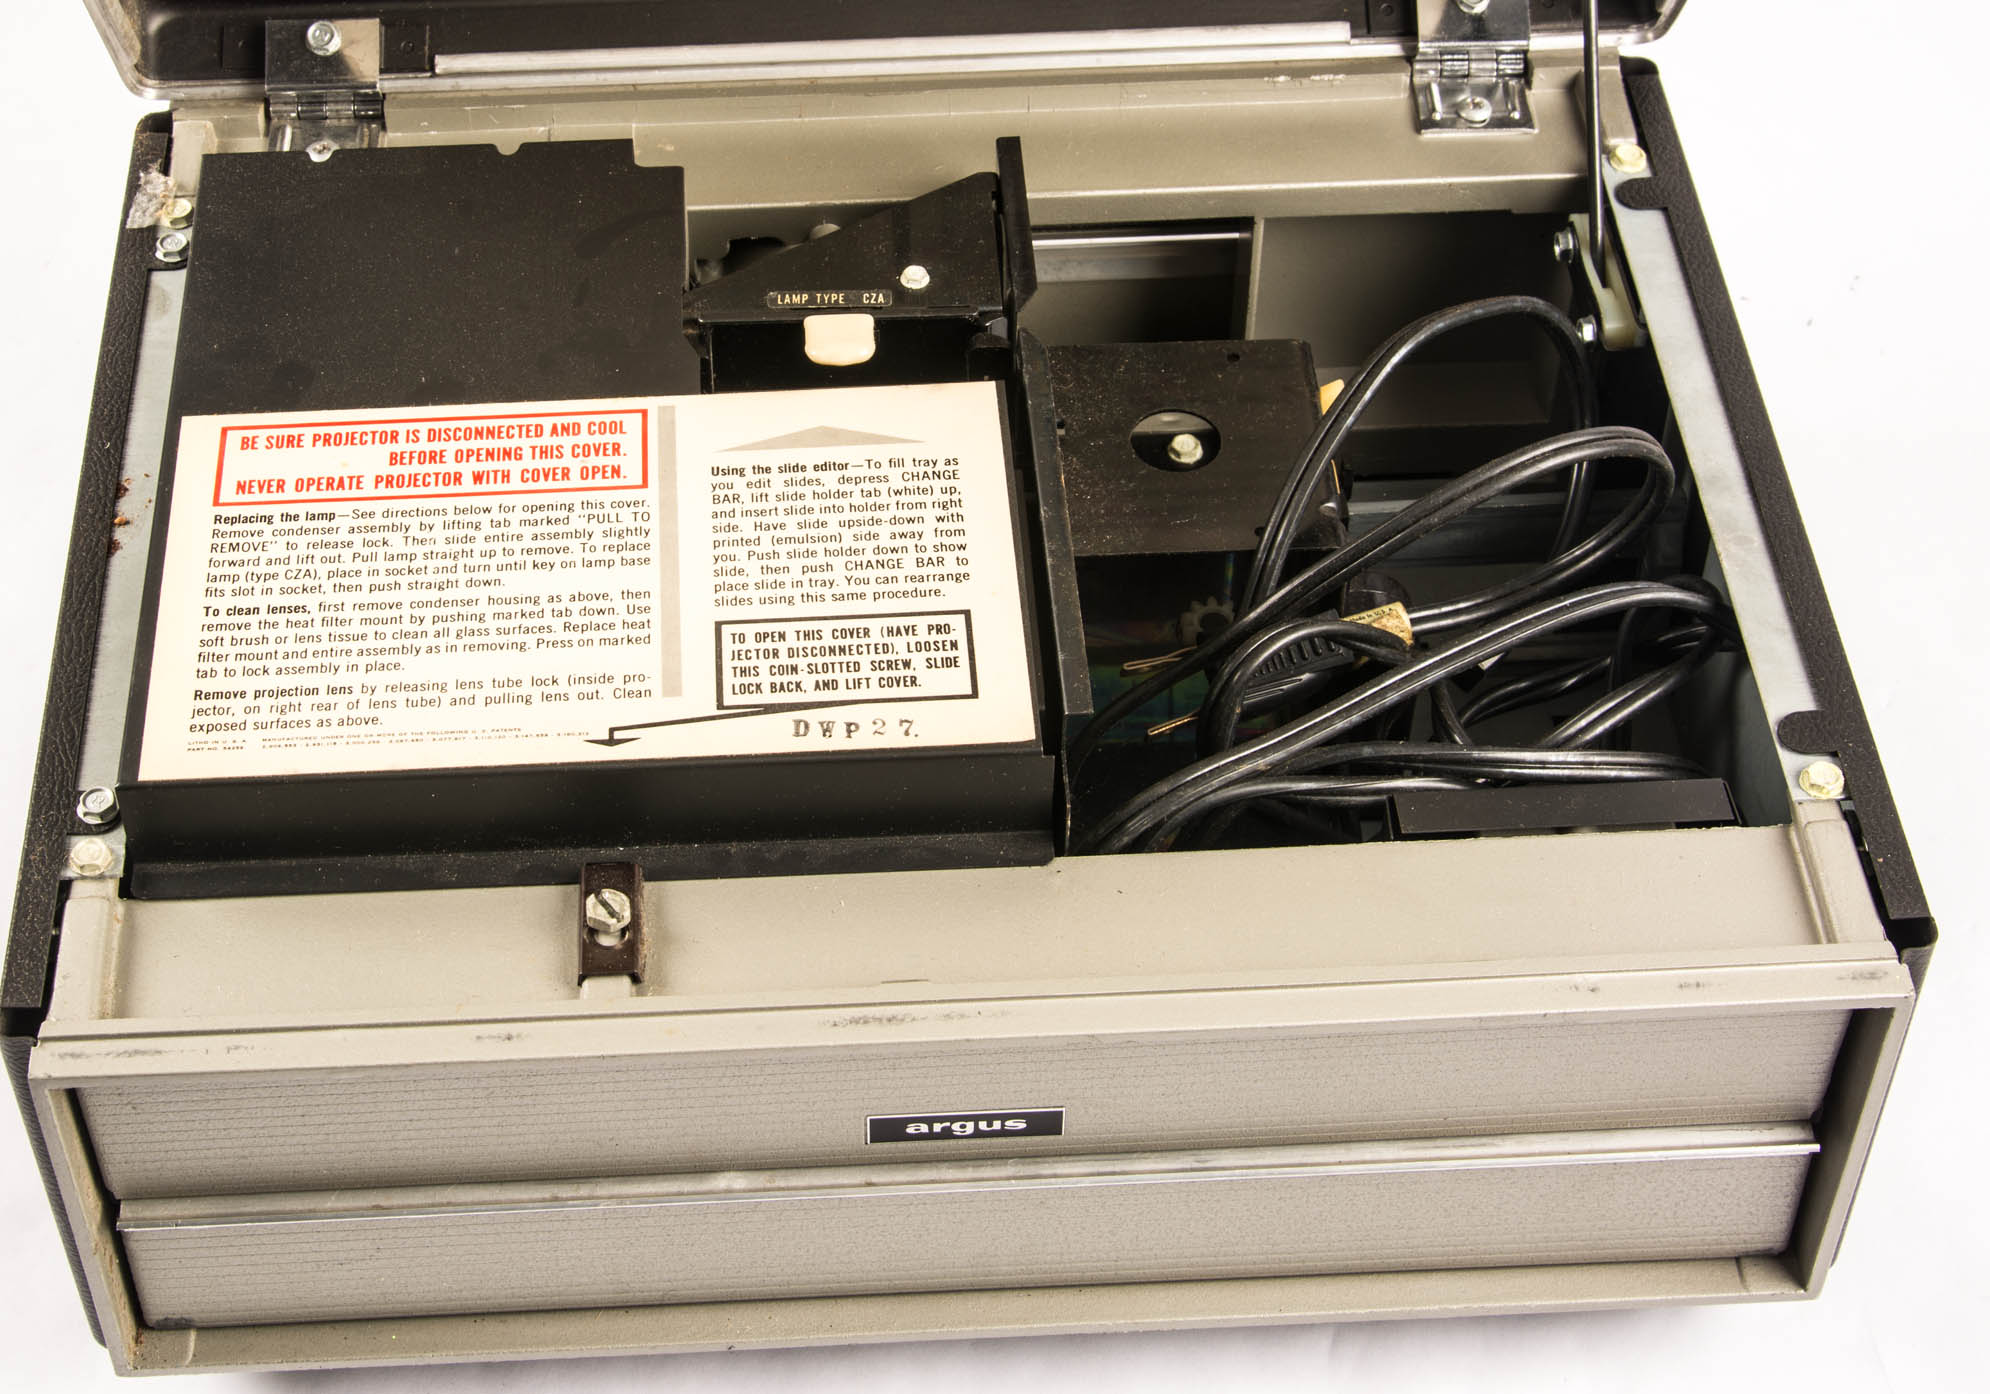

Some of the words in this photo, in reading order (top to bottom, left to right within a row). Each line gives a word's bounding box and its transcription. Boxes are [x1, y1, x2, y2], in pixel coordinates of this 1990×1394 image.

[777, 293, 809, 305] LAMP
[816, 292, 845, 304] TYPE
[863, 292, 884, 304] CZA
[240, 435, 259, 451] BE
[264, 433, 304, 450] SURE
[312, 429, 399, 448] PROJECTOR
[405, 428, 420, 444] IS
[426, 423, 544, 443] DISCONNECTED
[549, 421, 581, 437] AND
[587, 420, 627, 436] COOL
[388, 449, 447, 466] BEFORE
[454, 446, 523, 464] OPENING
[528, 444, 564, 460] THIS
[571, 442, 627, 457] COVER.
[711, 465, 746, 477] Using
[752, 464, 772, 475] the
[777, 462, 807, 474] slide
[888, 457, 904, 468] fill
[912, 457, 938, 469] tray
[944, 457, 959, 466] as
[235, 478, 286, 495] NEVER
[294, 474, 364, 493] OPERATE
[374, 471, 463, 489] PROJECTOR
[471, 469, 510, 486] WITH
[520, 466, 571, 483] COVER
[580, 464, 627, 480] OPEN.
[711, 482, 733, 493] you
[746, 478, 771, 489] edit
[783, 476, 825, 487] slides,
[837, 474, 889, 486] depress
[901, 469, 960, 482] CHANGE
[712, 493, 744, 505] BAR,
[751, 492, 768, 503] lift
[775, 490, 806, 502] slide
[812, 488, 854, 500] holder
[860, 487, 881, 498] tab
[887, 484, 933, 498] (white)
[940, 486, 961, 496] up,
[213, 512, 274, 527] Replacing
[280, 512, 300, 522] the
[381, 506, 447, 518] directions
[453, 504, 492, 515] below
[498, 503, 516, 514] for
[522, 503, 575, 514] opening
[581, 499, 605, 510] this
[610, 500, 650, 509] cover.
[711, 507, 735, 519] and
[741, 506, 778, 518] insert
[783, 504, 814, 516] slide
[819, 503, 844, 514] into
[849, 501, 891, 512] holder
[895, 500, 927, 511] from
[932, 498, 963, 511] right
[712, 522, 743, 533] side.
[754, 520, 786, 532] Have
[797, 518, 828, 530] slide
[838, 514, 924, 530] upside-down
[935, 512, 964, 523] with
[713, 535, 760, 550] printed
[771, 532, 842, 546] (emulsion)
[852, 530, 880, 542] side
[889, 530, 923, 541] away
[934, 527, 965, 538] from
[712, 553, 740, 565] you.
[747, 549, 780, 560] Push
[786, 547, 818, 559] slide
[824, 546, 866, 557] holder
[872, 544, 908, 556] down
[914, 543, 927, 553] to
[932, 541, 967, 553] show
[713, 565, 749, 577] slide,
[760, 564, 790, 575] then
[801, 561, 833, 576] push
[844, 557, 904, 571] CHANGE
[915, 556, 944, 568] BAR
[955, 556, 968, 566] to
[714, 581, 749, 594] place
[754, 579, 786, 590] slide
[791, 578, 803, 588] in
[808, 577, 839, 589] tray.
[844, 575, 870, 586] You
[875, 575, 898, 585] can
[904, 572, 970, 583] rearrange
[203, 606, 220, 617] To
[226, 605, 260, 616] clean
[266, 604, 311, 615] lenses,
[318, 601, 344, 613] first
[352, 601, 403, 611] remove
[409, 597, 480, 609] condenser
[487, 595, 540, 606] housing
[547, 594, 562, 603] as
[568, 591, 613, 602] above,
[621, 589, 650, 600] then
[714, 595, 753, 607] slides
[759, 593, 795, 606] using
[800, 591, 826, 603] this
[831, 592, 866, 602] same
[873, 587, 946, 602] procedure.
[730, 632, 746, 644] TO
[754, 631, 786, 643] OPEN
[794, 629, 823, 641] THIS
[831, 627, 871, 640] COVER
[880, 624, 919, 638] (HAVE
[927, 623, 956, 636] PRO-
[730, 648, 780, 661] JECTOR
[787, 642, 899, 659] DISCONNECTED),
[906, 639, 959, 653] LOOSEN
[195, 667, 217, 679] tab
[223, 666, 236, 678] to
[242, 665, 270, 677] lock
[275, 662, 340, 675] assembly
[346, 663, 358, 672] in
[365, 660, 404, 674] place.
[731, 665, 760, 678] THIS
[769, 660, 861, 676] COIN-SLOTTED
[870, 658, 916, 672] SCREW,
[925, 655, 960, 669] SLIDE
[193, 689, 247, 701] Remove
[253, 685, 319, 701] projection
[326, 684, 353, 696] lens
[361, 683, 376, 696] by
[385, 680, 448, 693] releasing
[455, 679, 483, 690] lens
[492, 677, 522, 688] tube
[531, 675, 559, 687] lock
[567, 673, 614, 687] (inside
[623, 673, 651, 685] pro-
[732, 682, 763, 695] LOCK
[769, 680, 807, 694] BACK,
[813, 678, 838, 692] AND
[845, 677, 872, 690] LIFT
[878, 675, 922, 688] COVER.
[905, 1118, 1028, 1136] argus
